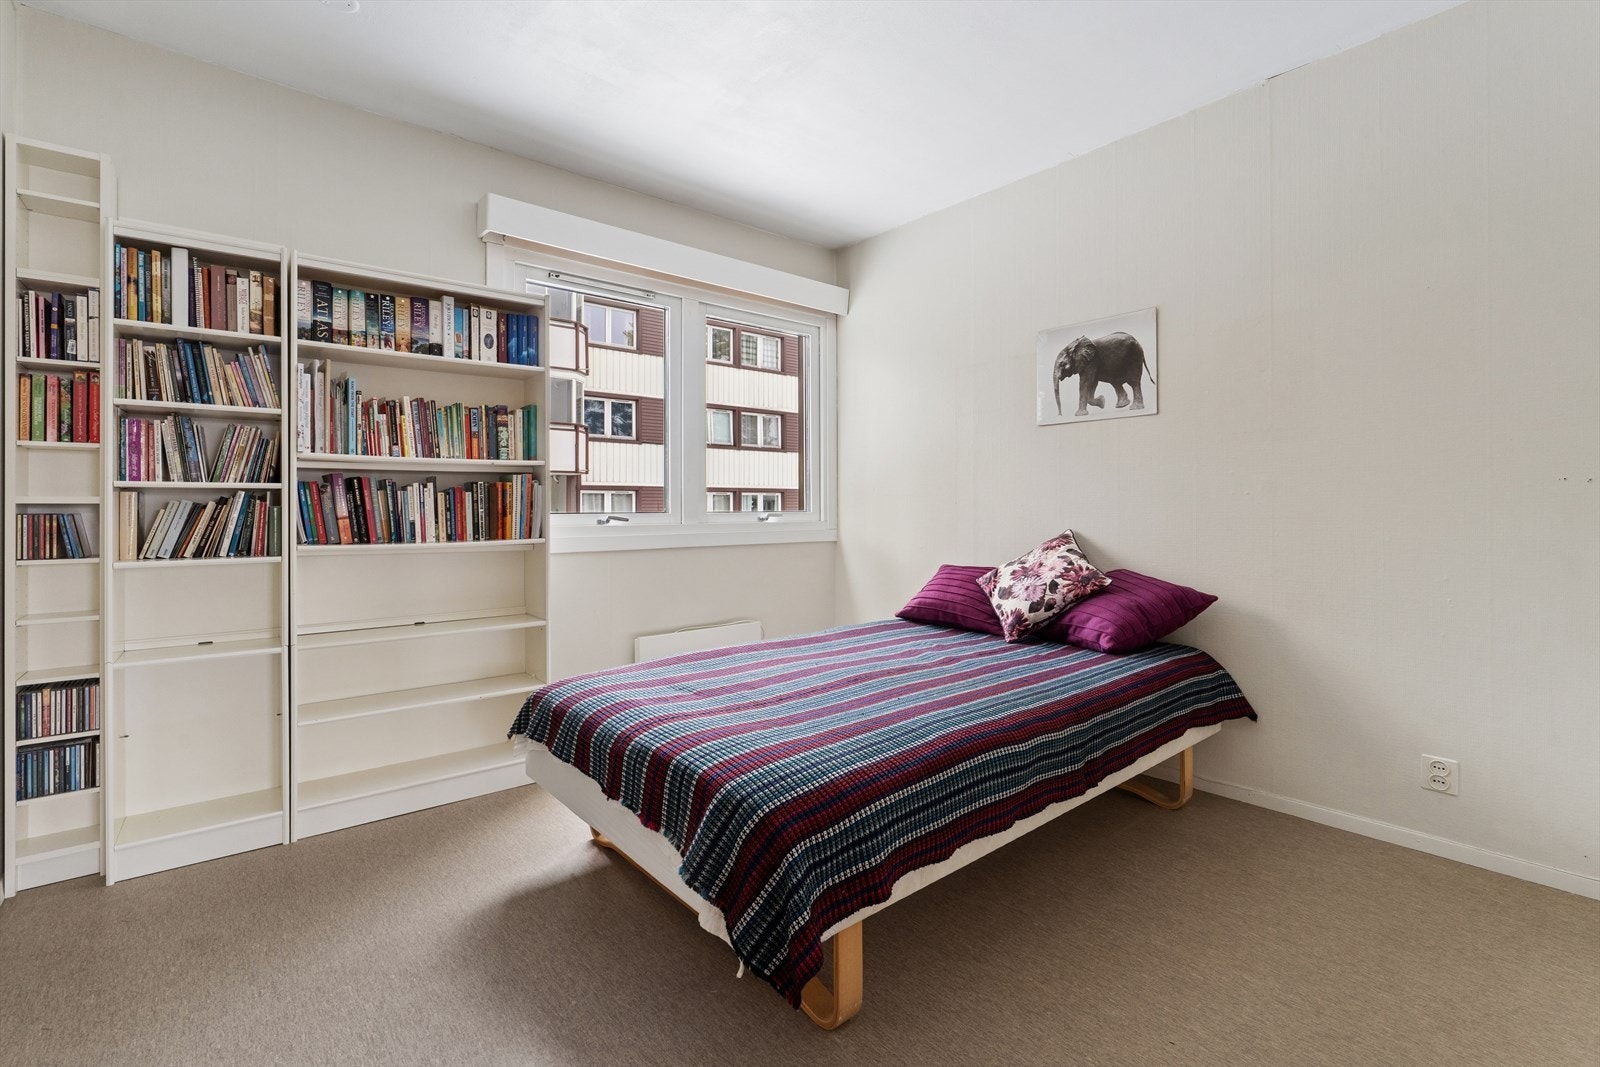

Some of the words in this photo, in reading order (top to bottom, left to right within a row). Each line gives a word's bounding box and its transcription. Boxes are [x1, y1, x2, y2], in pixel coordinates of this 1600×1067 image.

[298, 286, 306, 314] RILEY
[382, 300, 390, 327] RILEY
[317, 298, 328, 338] ATLAS
[413, 302, 421, 328] RILEY
